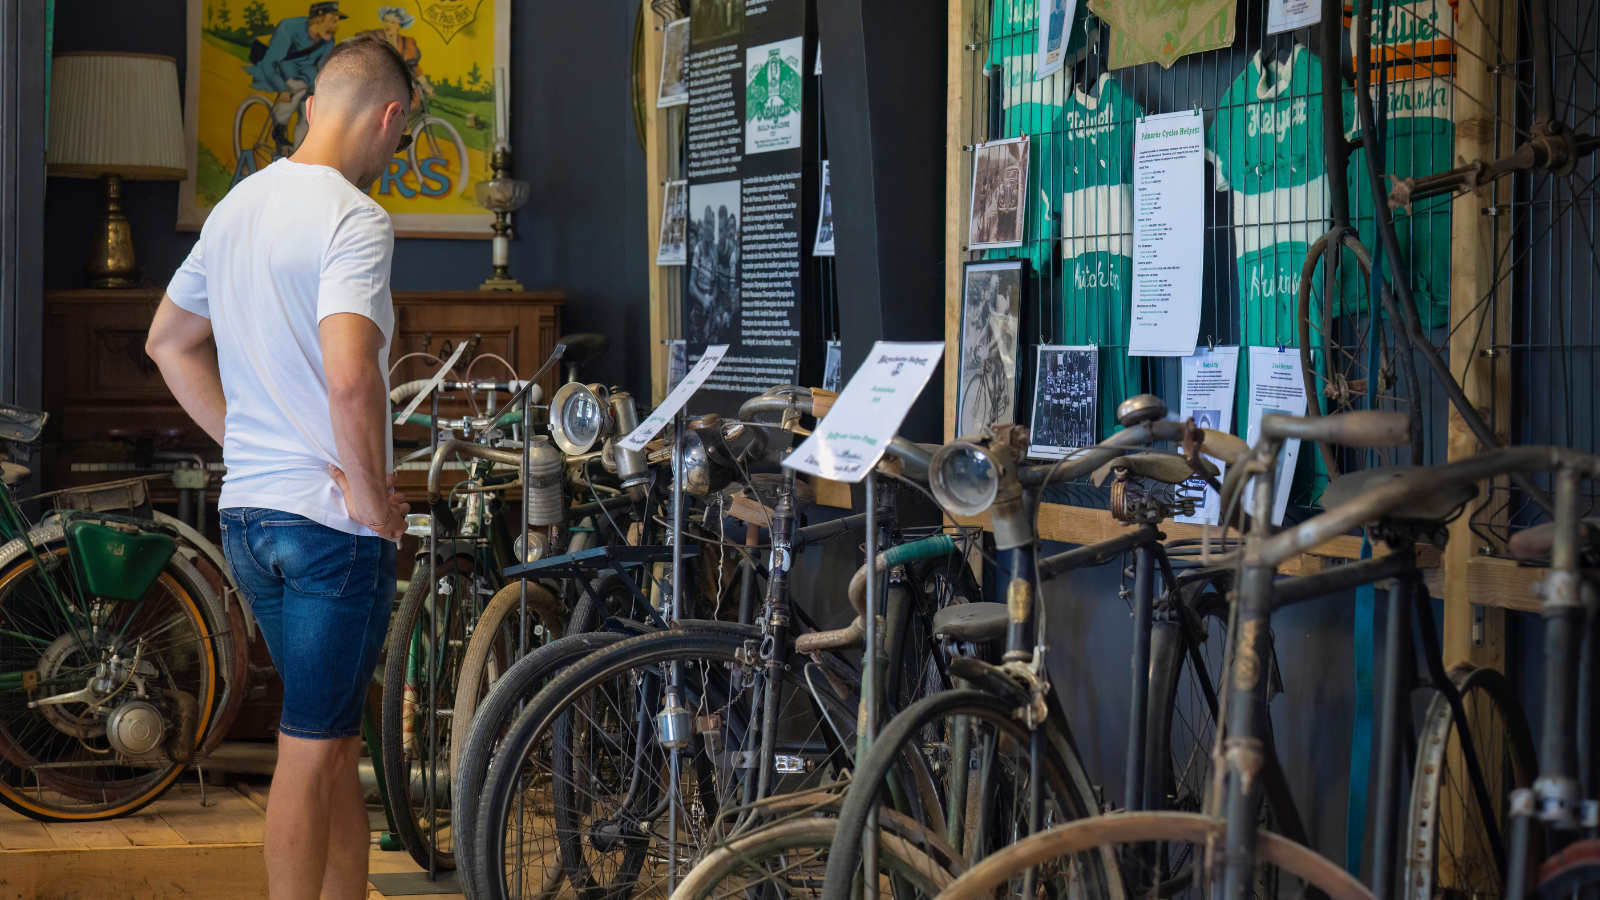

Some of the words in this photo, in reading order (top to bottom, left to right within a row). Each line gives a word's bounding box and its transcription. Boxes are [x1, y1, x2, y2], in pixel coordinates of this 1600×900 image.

[1067, 102, 1114, 145] Helyett
[1162, 129, 1178, 138] Cycles
[1180, 126, 1200, 136] Helyett
[1246, 98, 1307, 143] Helyett
